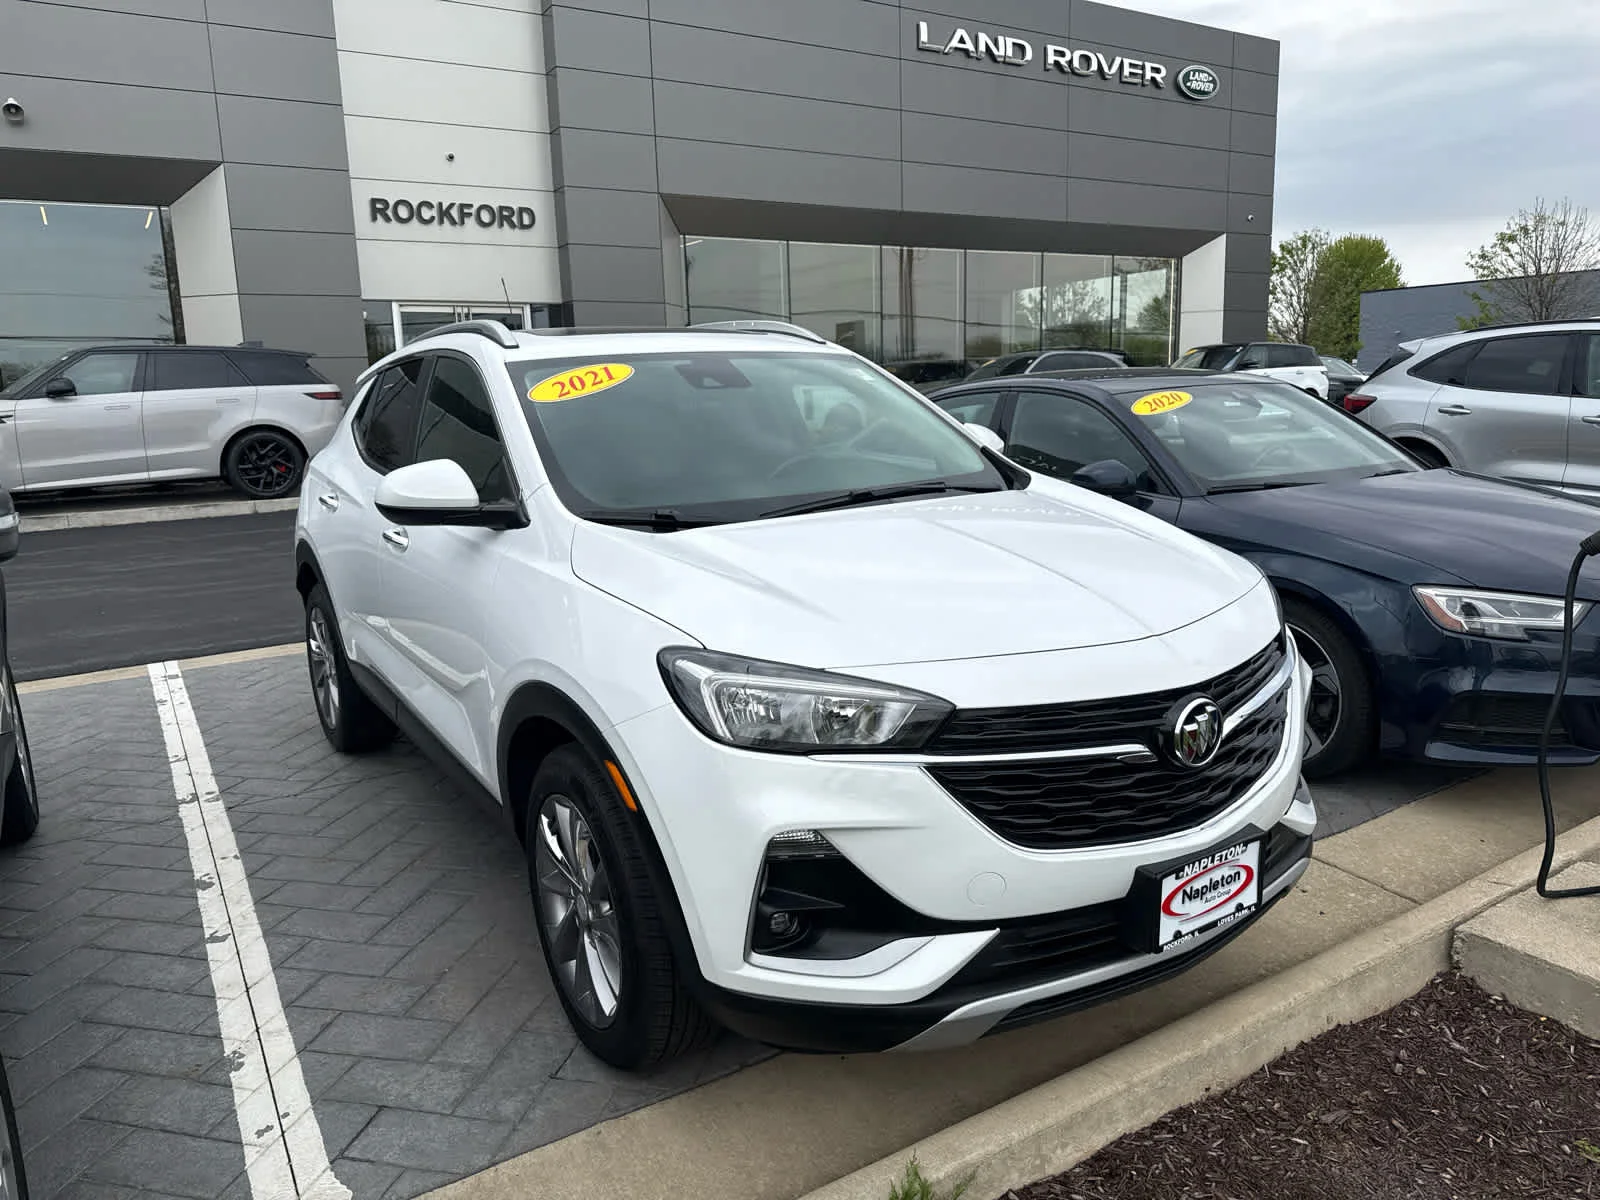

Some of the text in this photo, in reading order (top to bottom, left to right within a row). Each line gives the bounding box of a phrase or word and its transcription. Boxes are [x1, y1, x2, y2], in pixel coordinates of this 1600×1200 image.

[917, 21, 1167, 88] LAND ROVER
[1189, 70, 1209, 82] LAND
[1190, 80, 1214, 92] ROVER
[369, 197, 537, 230] ROCKFORD
[551, 366, 616, 398] 2021
[1142, 393, 1184, 413] 2020
[1181, 870, 1241, 905] Napleton
[1204, 894, 1217, 905] Auto
